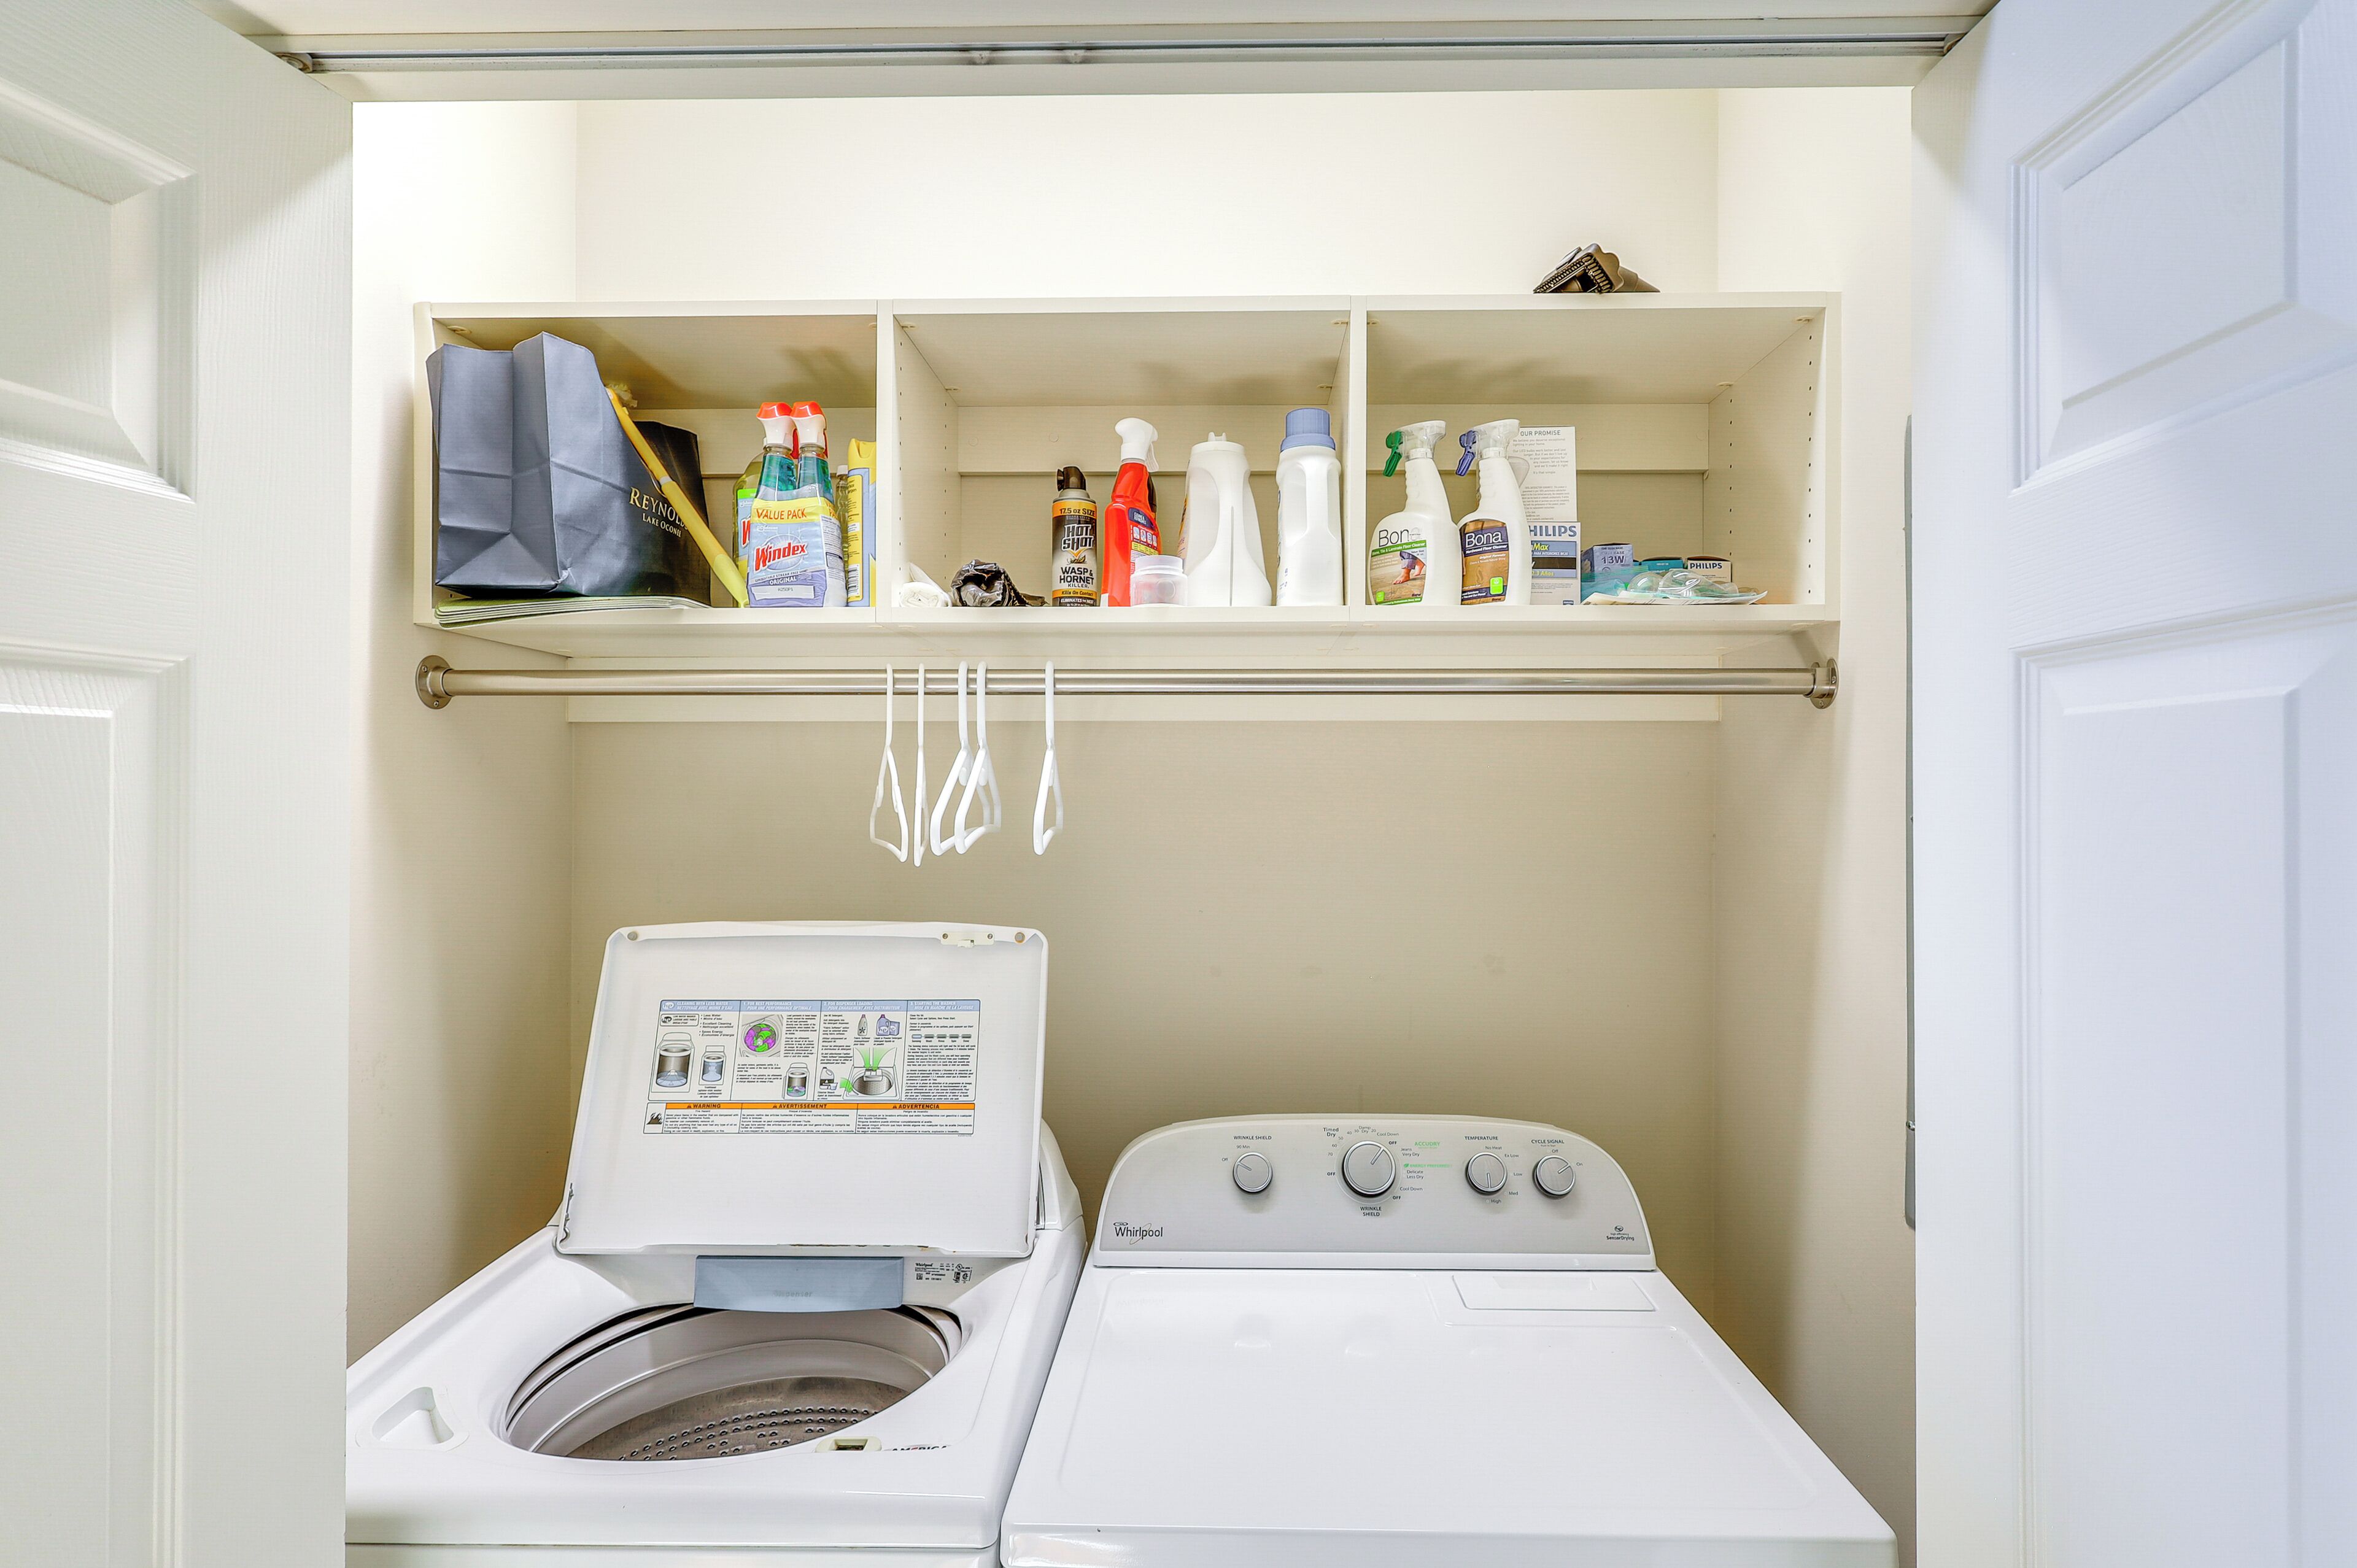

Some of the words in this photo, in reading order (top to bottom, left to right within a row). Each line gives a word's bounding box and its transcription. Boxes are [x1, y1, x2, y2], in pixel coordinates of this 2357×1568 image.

[629, 487, 687, 530] REYNOL
[756, 509, 784, 520] VALUE
[787, 508, 807, 519] PACK
[1082, 508, 1095, 517] SIZE
[642, 513, 659, 527] LAKE
[1064, 523, 1092, 538] HOT
[1379, 528, 1418, 547] Bon
[1528, 525, 1577, 537] HILIPS
[1061, 536, 1094, 552] SHOT
[1466, 531, 1503, 548] Bona
[755, 542, 806, 571] Windex
[1601, 555, 1625, 564] 13W
[1061, 566, 1088, 575] WASP
[770, 576, 797, 585] ORIGINAL
[1059, 575, 1094, 585] HORNET
[1115, 1226, 1163, 1240] Whirlpool
